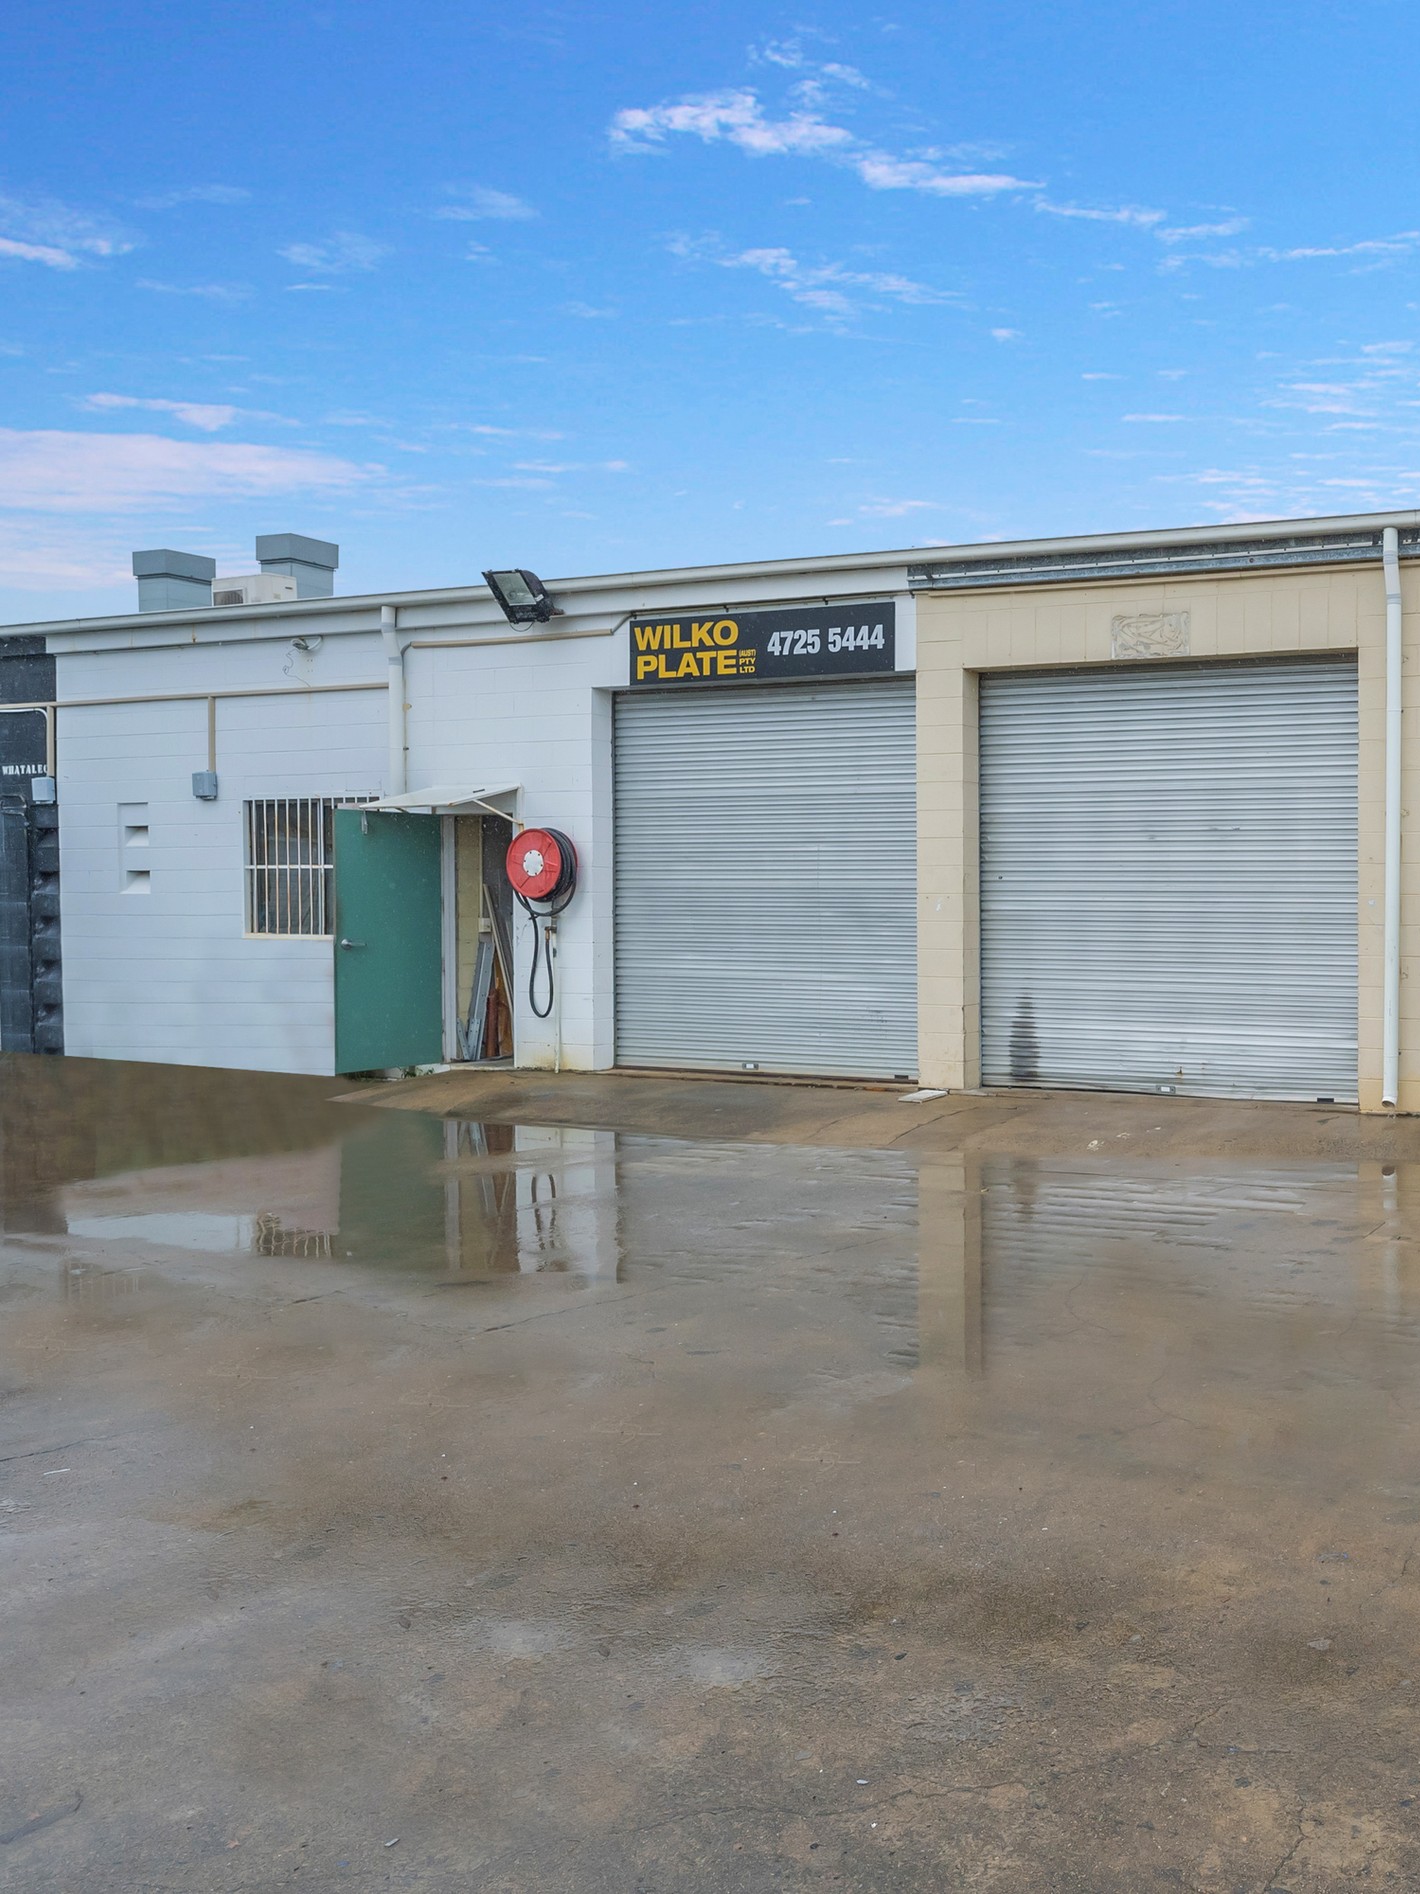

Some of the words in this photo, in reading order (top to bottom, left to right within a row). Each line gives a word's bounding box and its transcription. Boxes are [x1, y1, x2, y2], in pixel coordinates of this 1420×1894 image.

[634, 619, 739, 651] WILKO
[767, 629, 821, 656] 4725
[828, 624, 885, 653] 5444
[636, 649, 737, 680] PLATE
[739, 657, 756, 665] PTY
[739, 665, 755, 673] LTD
